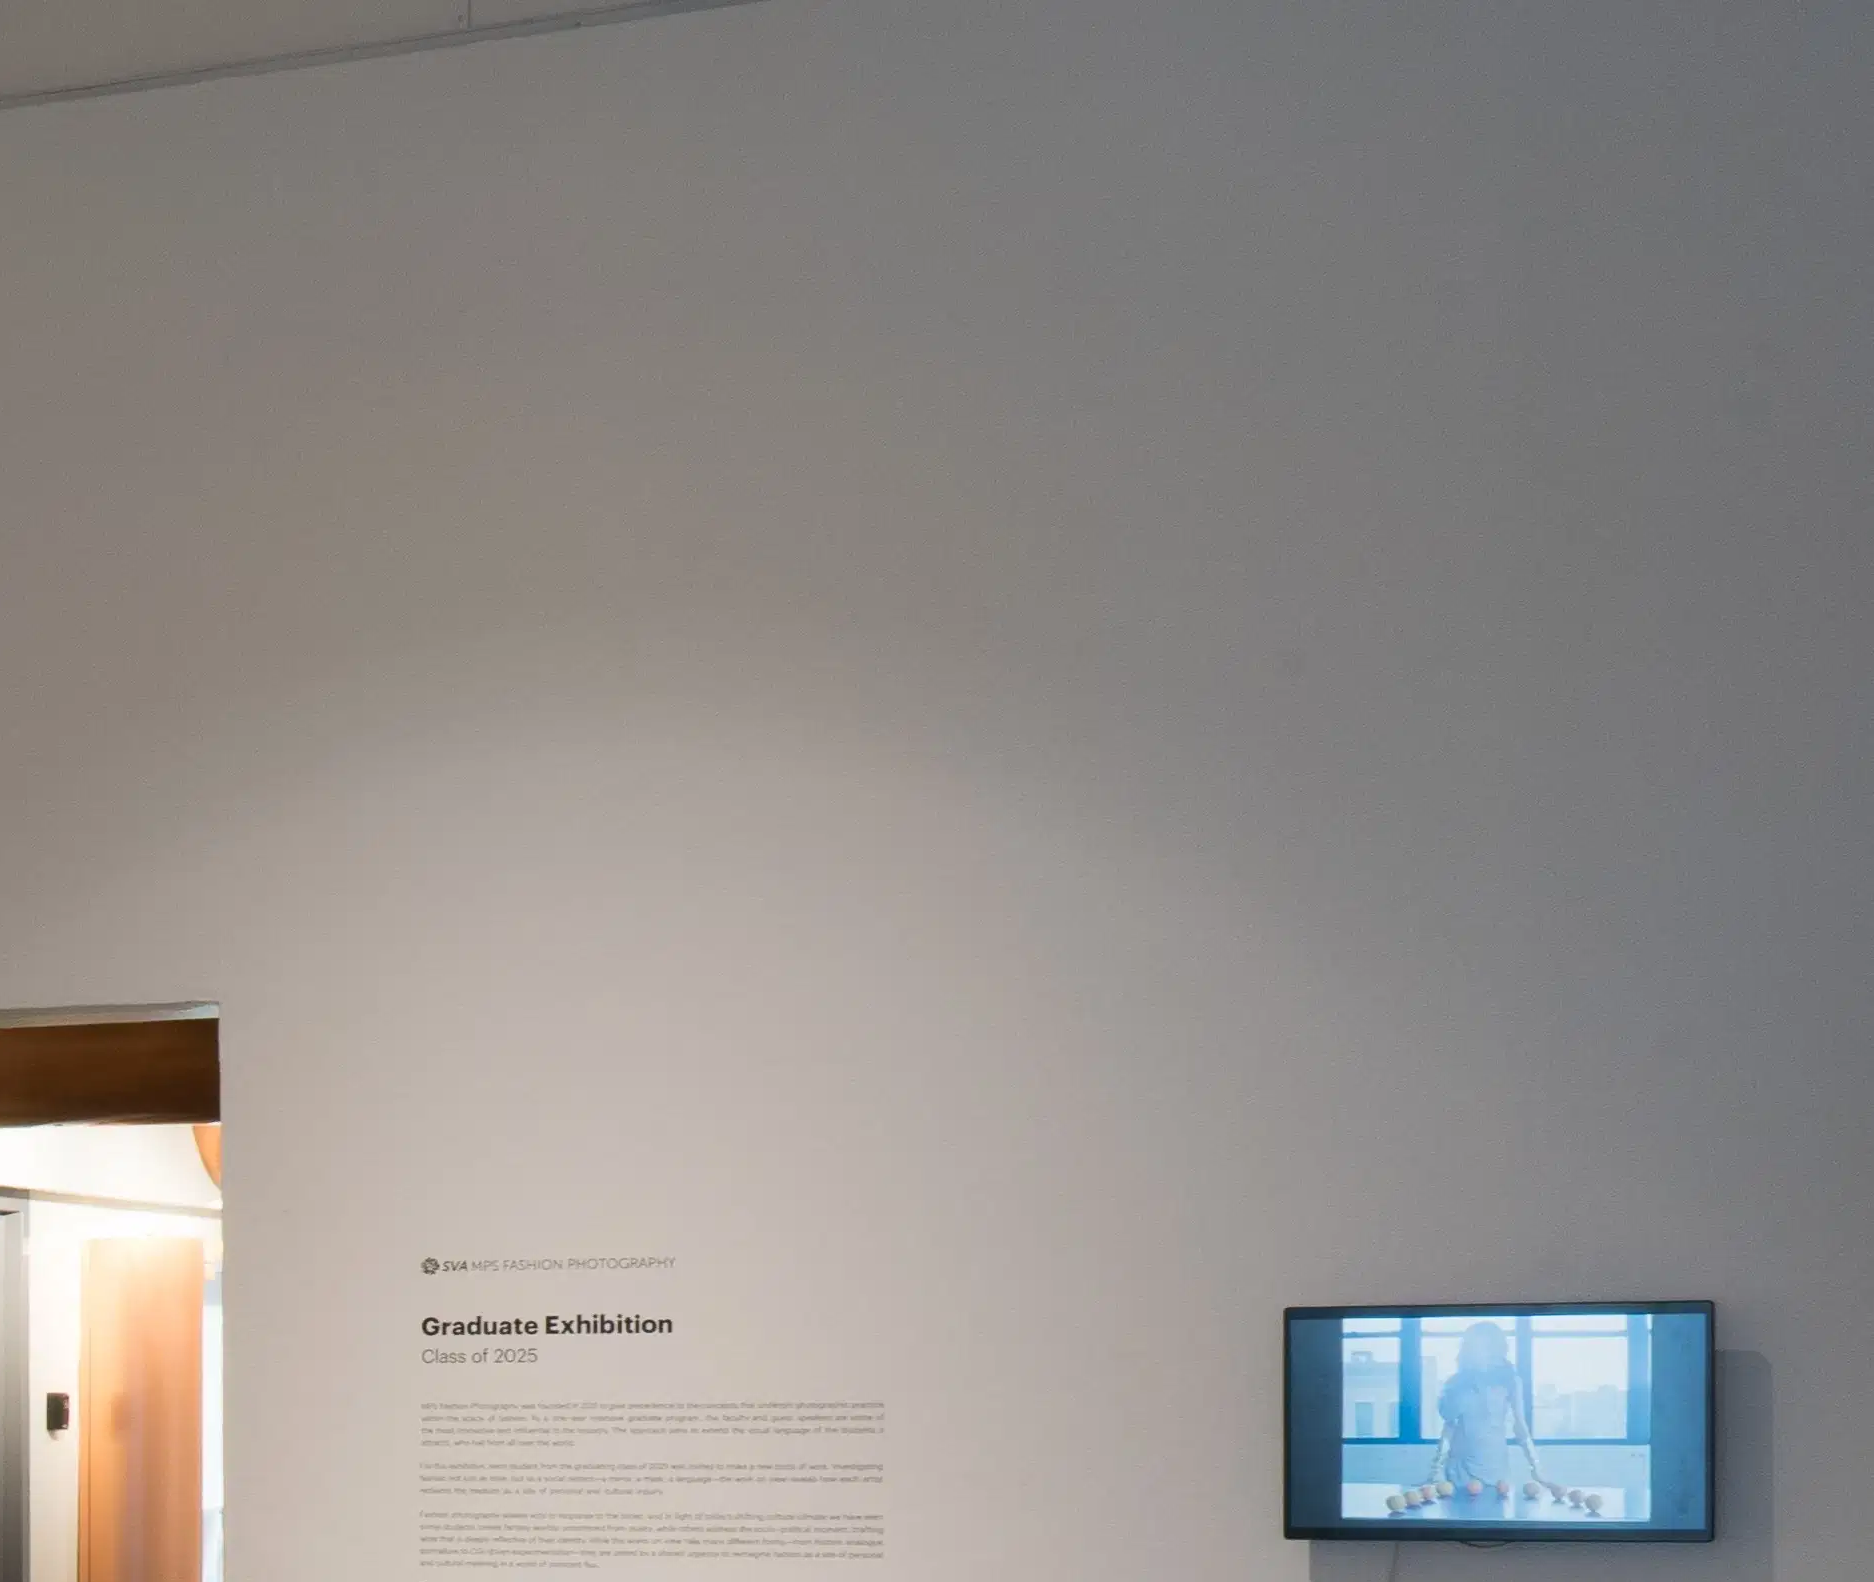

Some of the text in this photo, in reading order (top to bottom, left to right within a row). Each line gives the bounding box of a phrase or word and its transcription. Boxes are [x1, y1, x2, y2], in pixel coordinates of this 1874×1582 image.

[442, 1257, 676, 1272] SVA MPS FASHION PHOTOGRAPHY
[421, 1314, 673, 1336] Graduate Exhibition
[421, 1348, 538, 1364] Class of 2025
